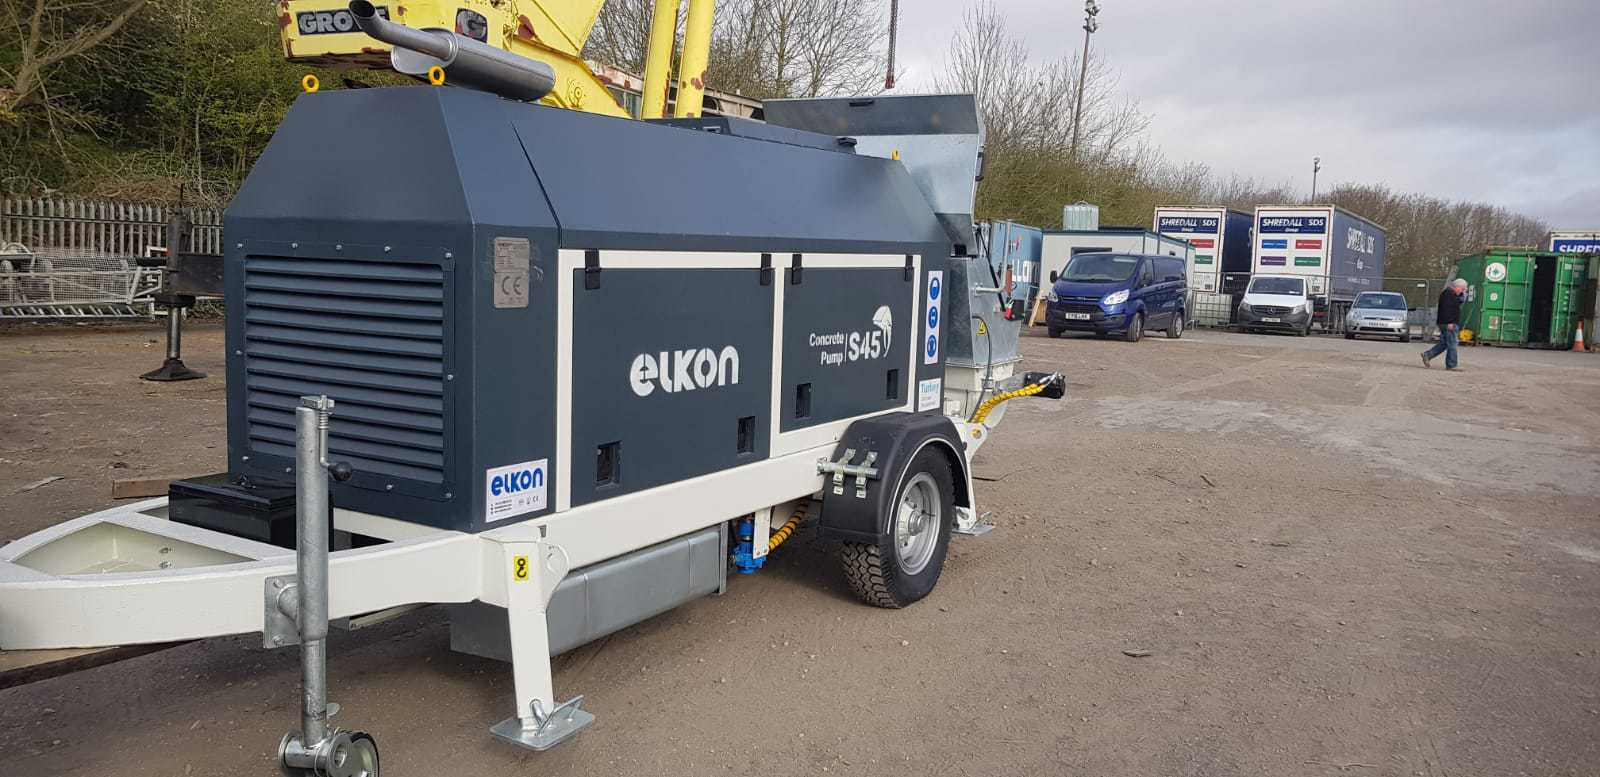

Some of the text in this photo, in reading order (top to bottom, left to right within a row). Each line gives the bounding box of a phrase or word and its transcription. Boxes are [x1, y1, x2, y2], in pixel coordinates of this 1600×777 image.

[1160, 218, 1217, 227] SHREDALL SDS
[1262, 218, 1324, 227] SHREDALL SDS
[809, 330, 881, 361] Concrete S45
[820, 351, 844, 367] Pump
